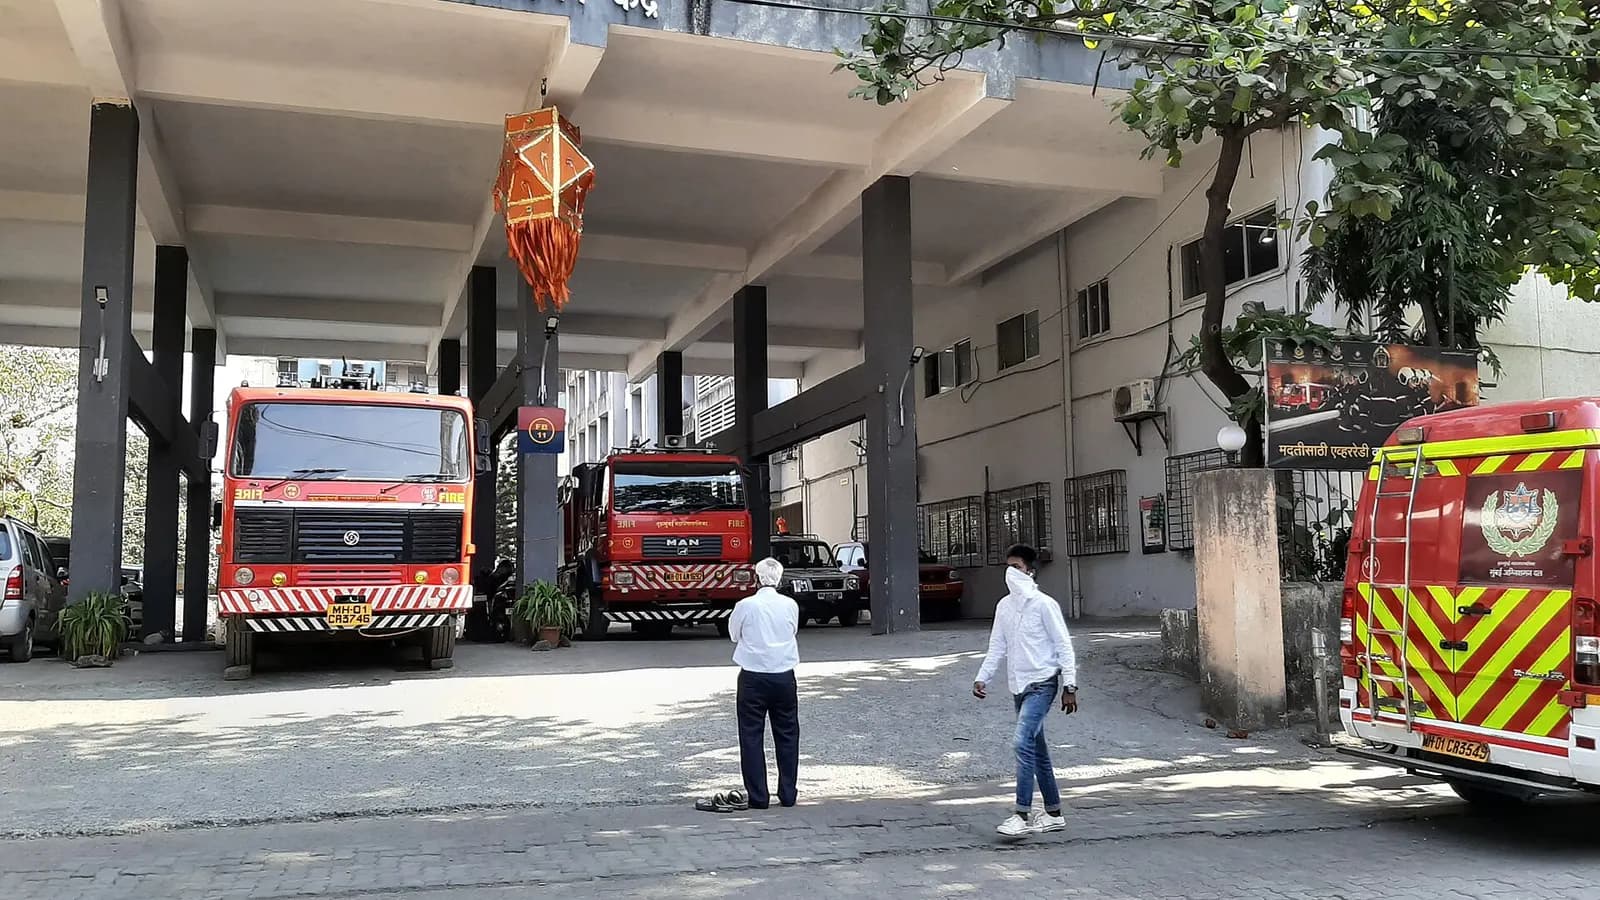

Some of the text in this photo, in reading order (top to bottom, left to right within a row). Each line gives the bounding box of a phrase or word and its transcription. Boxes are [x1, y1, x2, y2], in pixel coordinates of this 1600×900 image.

[1278, 441, 1329, 457] मदतीसाठी
[1330, 442, 1370, 459] एव्हररेडी
[438, 492, 465, 503] FIRE
[728, 519, 745, 528] FIRE
